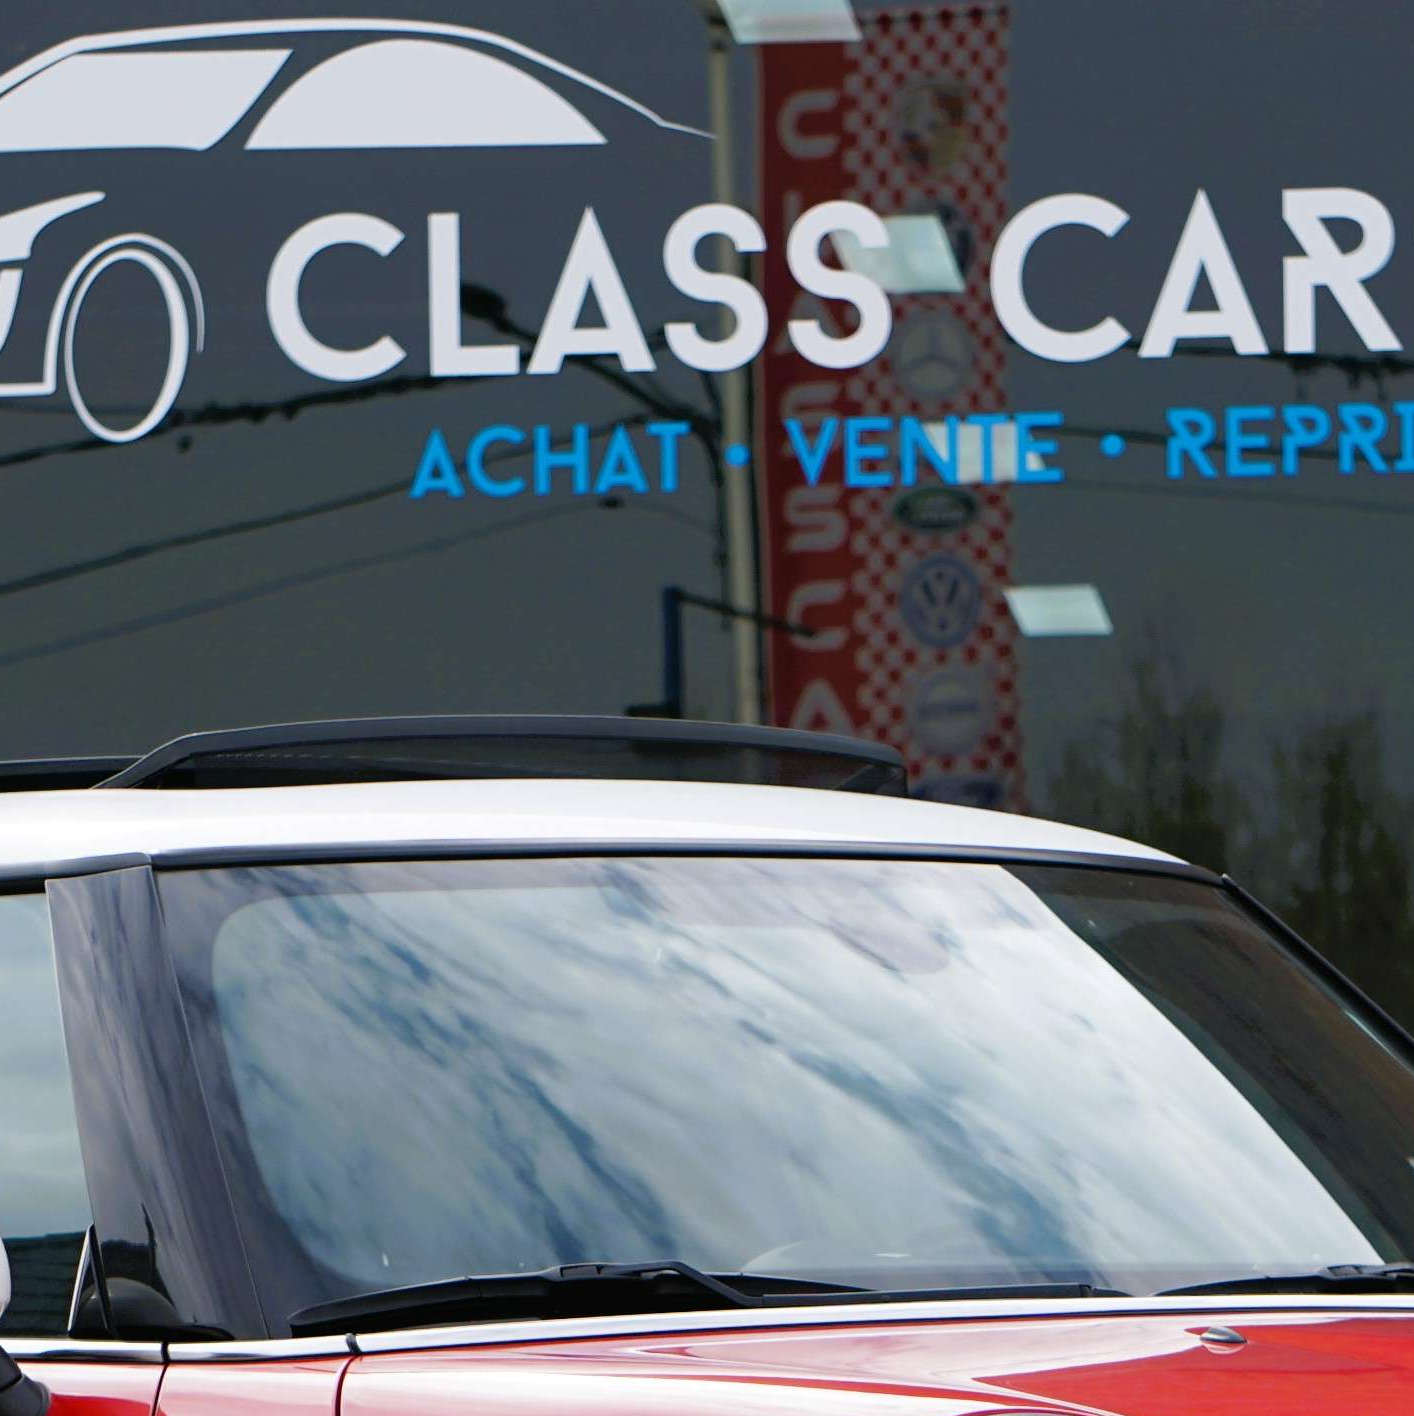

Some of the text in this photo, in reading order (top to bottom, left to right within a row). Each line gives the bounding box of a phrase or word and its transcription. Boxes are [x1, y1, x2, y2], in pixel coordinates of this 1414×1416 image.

[266, 202, 892, 382] CLASS
[409, 420, 690, 500] ACHAT
[786, 412, 1065, 489] VENTE
